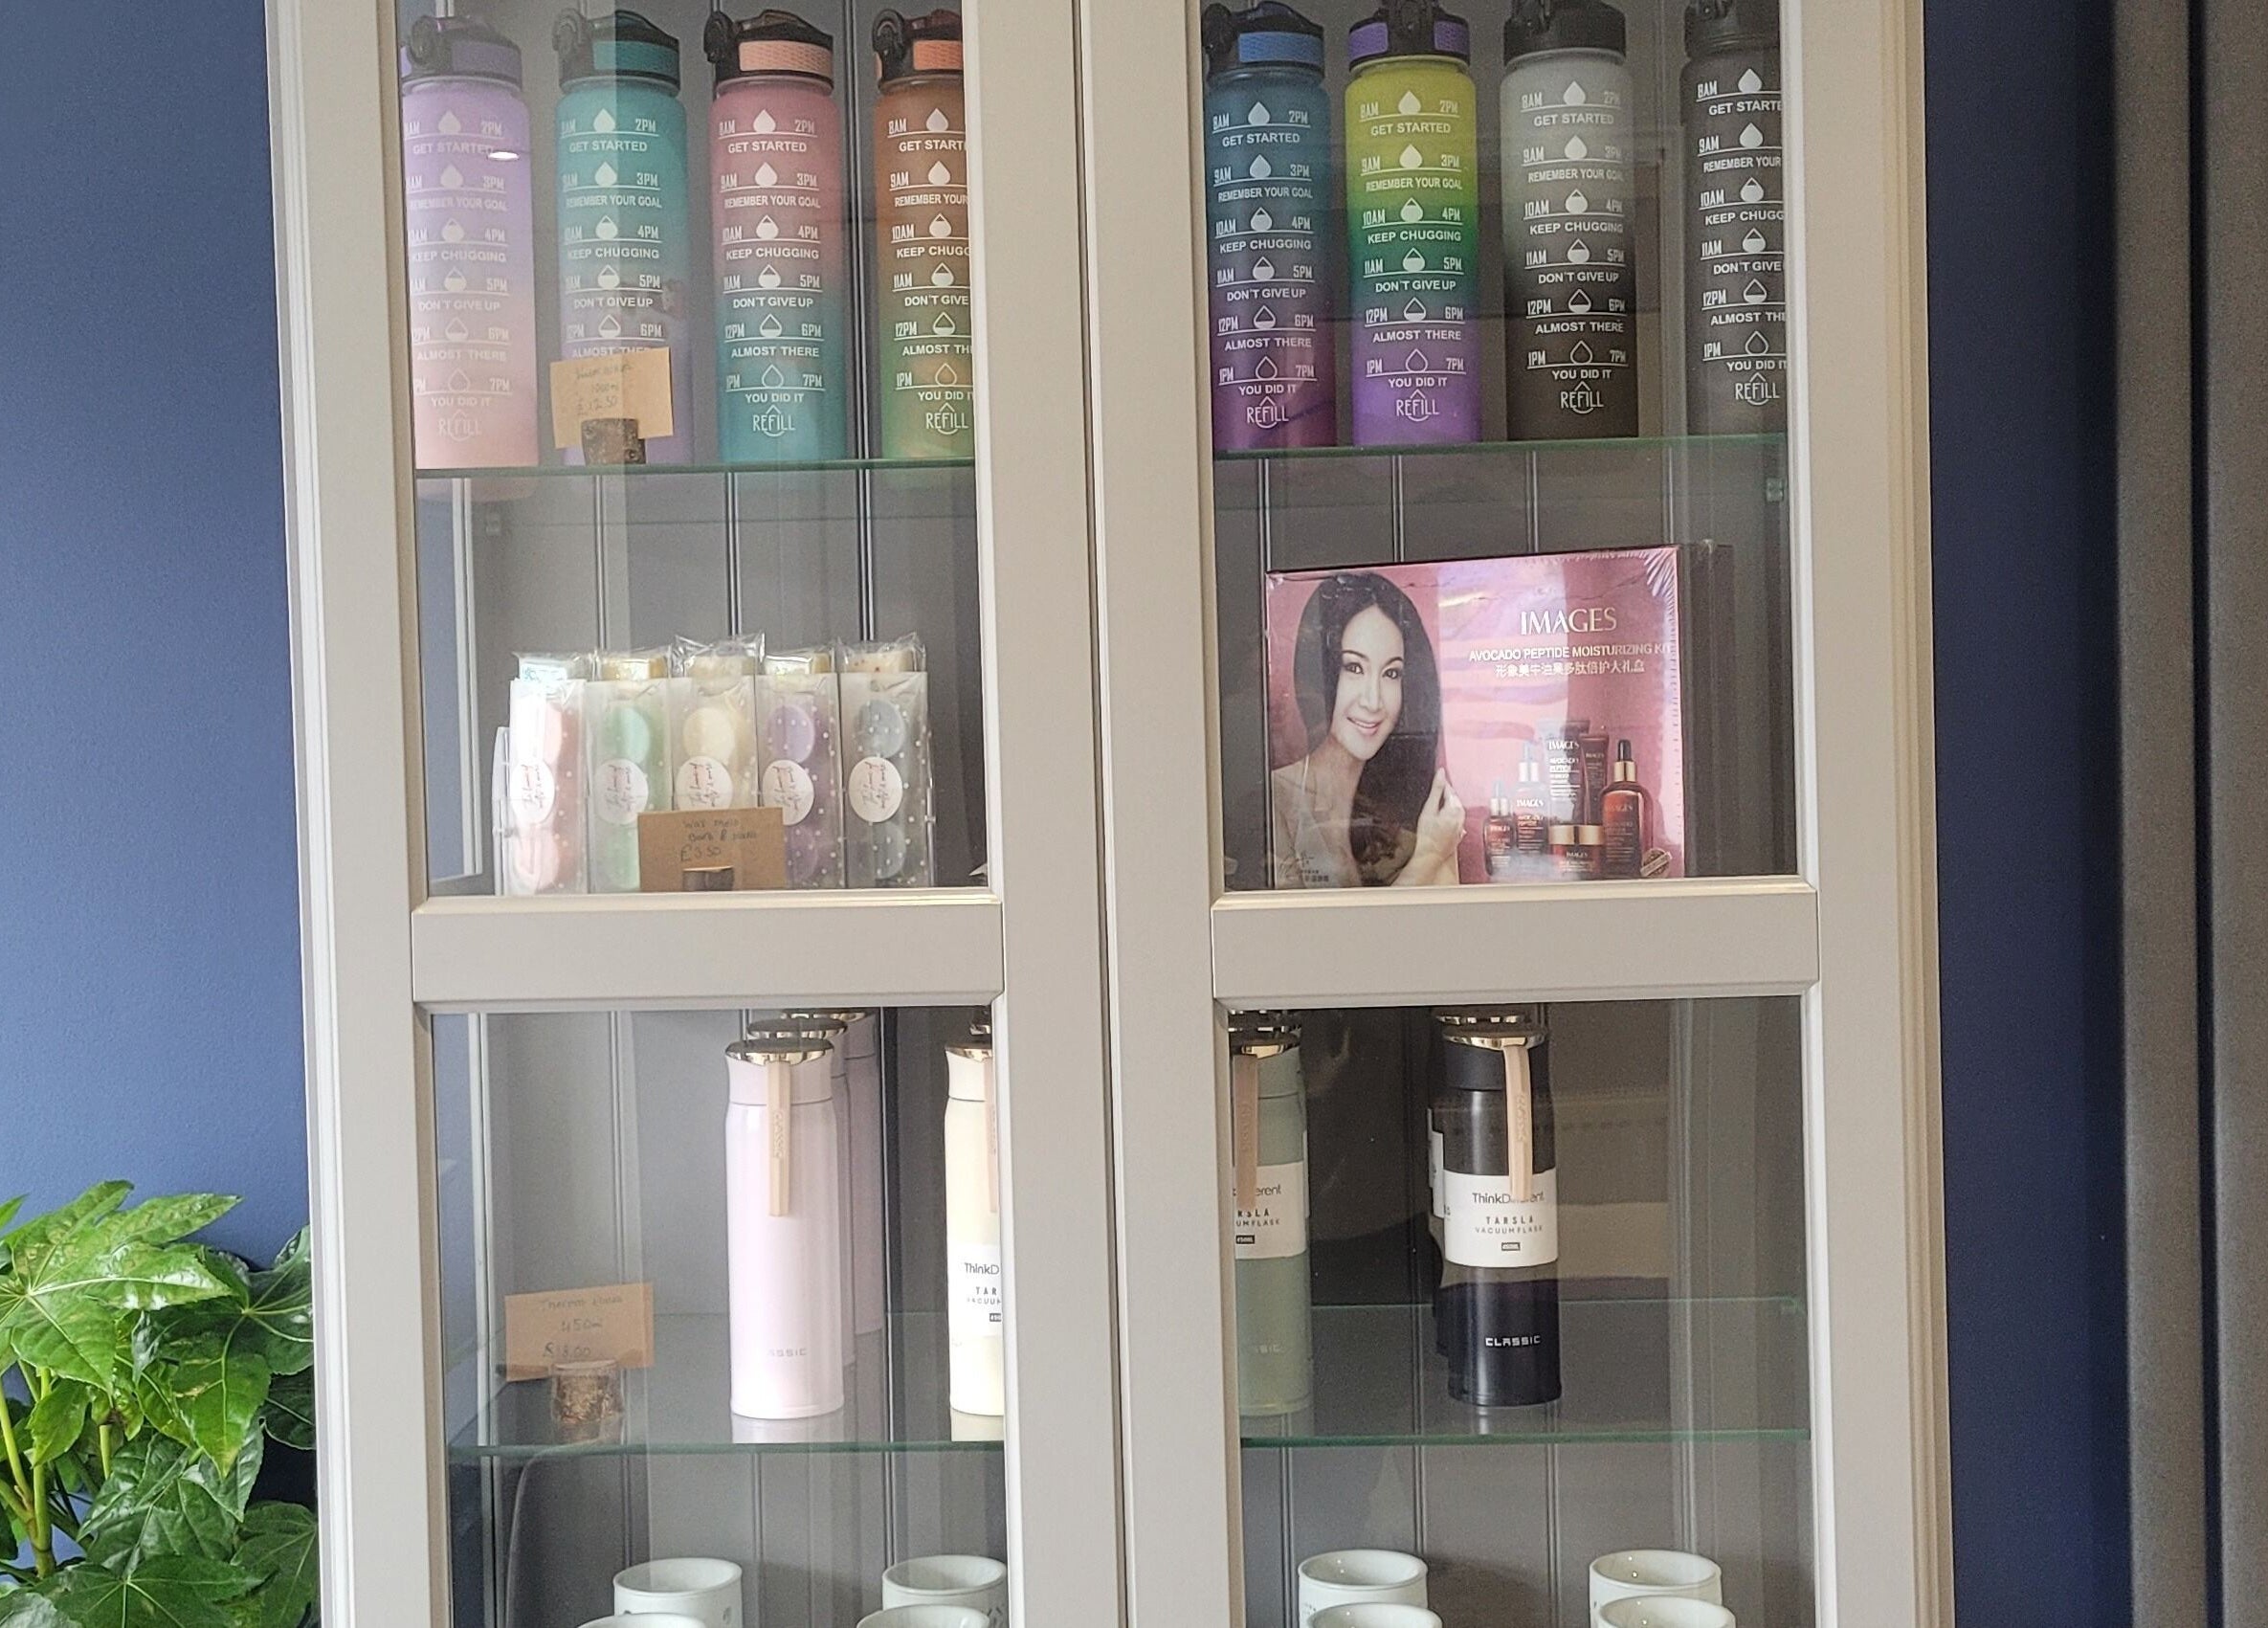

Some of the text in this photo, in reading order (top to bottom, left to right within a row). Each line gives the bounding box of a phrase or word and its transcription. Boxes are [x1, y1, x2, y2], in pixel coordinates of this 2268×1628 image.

[1698, 80, 1718, 99] 8AM
[1522, 92, 1543, 109] 8AM
[1709, 102, 1734, 116] GET
[1288, 110, 1308, 124] 2PM
[1534, 113, 1614, 127] GET STARTED
[635, 119, 656, 132] 2PM
[888, 118, 907, 134] 8AM
[1371, 122, 1451, 136] GET STARTED
[569, 141, 647, 152] GET STARTED
[899, 141, 922, 152] GET
[1222, 133, 1300, 146] GET STARTED
[1699, 135, 1720, 153] 9AM
[728, 141, 807, 153] GET STARTED
[1440, 154, 1459, 167] 3PM
[1523, 146, 1545, 164] 9AM
[1290, 164, 1310, 177] 3PM
[1362, 155, 1381, 172] 9AM
[1703, 156, 1781, 172] REMEMBER YOUR
[636, 172, 658, 186] 3PM
[796, 172, 817, 187] 3PM
[890, 171, 909, 189] 9AM
[1528, 168, 1605, 184] REMEMBER YOUR
[1366, 177, 1462, 192] REMEMBER YOUR GOAL
[610, 195, 662, 208] YOUR GOAL
[895, 193, 942, 208] REMEMBER
[1218, 187, 1313, 202] REMEMBER YOUR GOAL
[1701, 190, 1724, 207] 10AM
[769, 195, 821, 209] YOUR GOAL
[1525, 199, 1549, 216] 10AM
[1363, 209, 1386, 226] 10AM
[1442, 207, 1460, 221] 4PM
[1705, 212, 1736, 226] KEEP
[1292, 216, 1311, 230] 4PM
[1530, 221, 1623, 235] KEEP CHUGGING
[637, 226, 658, 238] 4PM
[797, 225, 818, 239] 4PM
[892, 224, 915, 240] 10AM
[1367, 230, 1461, 244] KEEP CHUGGING
[595, 248, 659, 258] CHUGGING
[897, 246, 925, 258] KEEP
[1219, 238, 1311, 254] KEEP CHUGGING
[1701, 239, 1722, 256] 11AM
[726, 248, 819, 260] KEEP CHUGGING
[1526, 249, 1546, 266] 11AM
[1443, 256, 1462, 271] 5PM
[1713, 261, 1782, 275] DON'T GIVE
[1293, 265, 1312, 279] 5PM
[1538, 271, 1619, 284] DON'T GIVE UP
[639, 275, 660, 288] 5PM
[799, 275, 820, 288] 5PM
[1375, 279, 1456, 293] DON'T GIVE UP
[904, 295, 969, 306] DON'T GIVE
[1227, 288, 1306, 301] DON'T GIVE UP
[1703, 289, 1726, 306] 12PM
[607, 298, 653, 307] GIVE UP
[767, 297, 813, 307] GIVE UP
[1527, 299, 1551, 316] 12PM
[1366, 307, 1388, 324] 12PM
[1445, 306, 1463, 320] 6PM
[1711, 312, 1762, 325] ALMOST
[640, 323, 662, 337] 6PM
[801, 323, 822, 337] 6PM
[895, 322, 918, 337] 12PM
[1535, 322, 1624, 335] ALMOST THERE
[1372, 329, 1462, 344] ALMOST THERE
[902, 345, 950, 356] ALMOST
[1225, 337, 1312, 351] ALMOST THERE
[1704, 342, 1721, 358] 1PM
[731, 346, 820, 358] ALMOST THERE
[1528, 350, 1545, 366] 1PM
[1367, 358, 1383, 374] 1PM
[1446, 357, 1464, 370] 7PM
[1726, 360, 1775, 371] YOU DID
[1296, 365, 1314, 377] 7PM
[1552, 369, 1612, 380] YOU DID IT
[803, 373, 823, 387] 7PM
[896, 371, 912, 387] 1PM
[1388, 377, 1448, 389] YOU DID IT
[918, 391, 964, 401] YOU DID
[1238, 384, 1297, 396] YOU DID IT
[1735, 383, 1779, 400] REFILL
[745, 393, 804, 403] YOU DID IT
[1561, 390, 1604, 409] REFILL
[1396, 399, 1440, 416] REFILL
[925, 413, 969, 429] REFILL
[1246, 406, 1289, 424] REFILL
[752, 414, 796, 432] REFILL
[1520, 607, 1617, 636] IMAGES
[1469, 649, 1522, 661] AVOCADO
[1523, 646, 1569, 658] PEPTIDE
[1571, 643, 1653, 658] MOISTURIZING
[1485, 1335, 1541, 1347] CLASSIC
